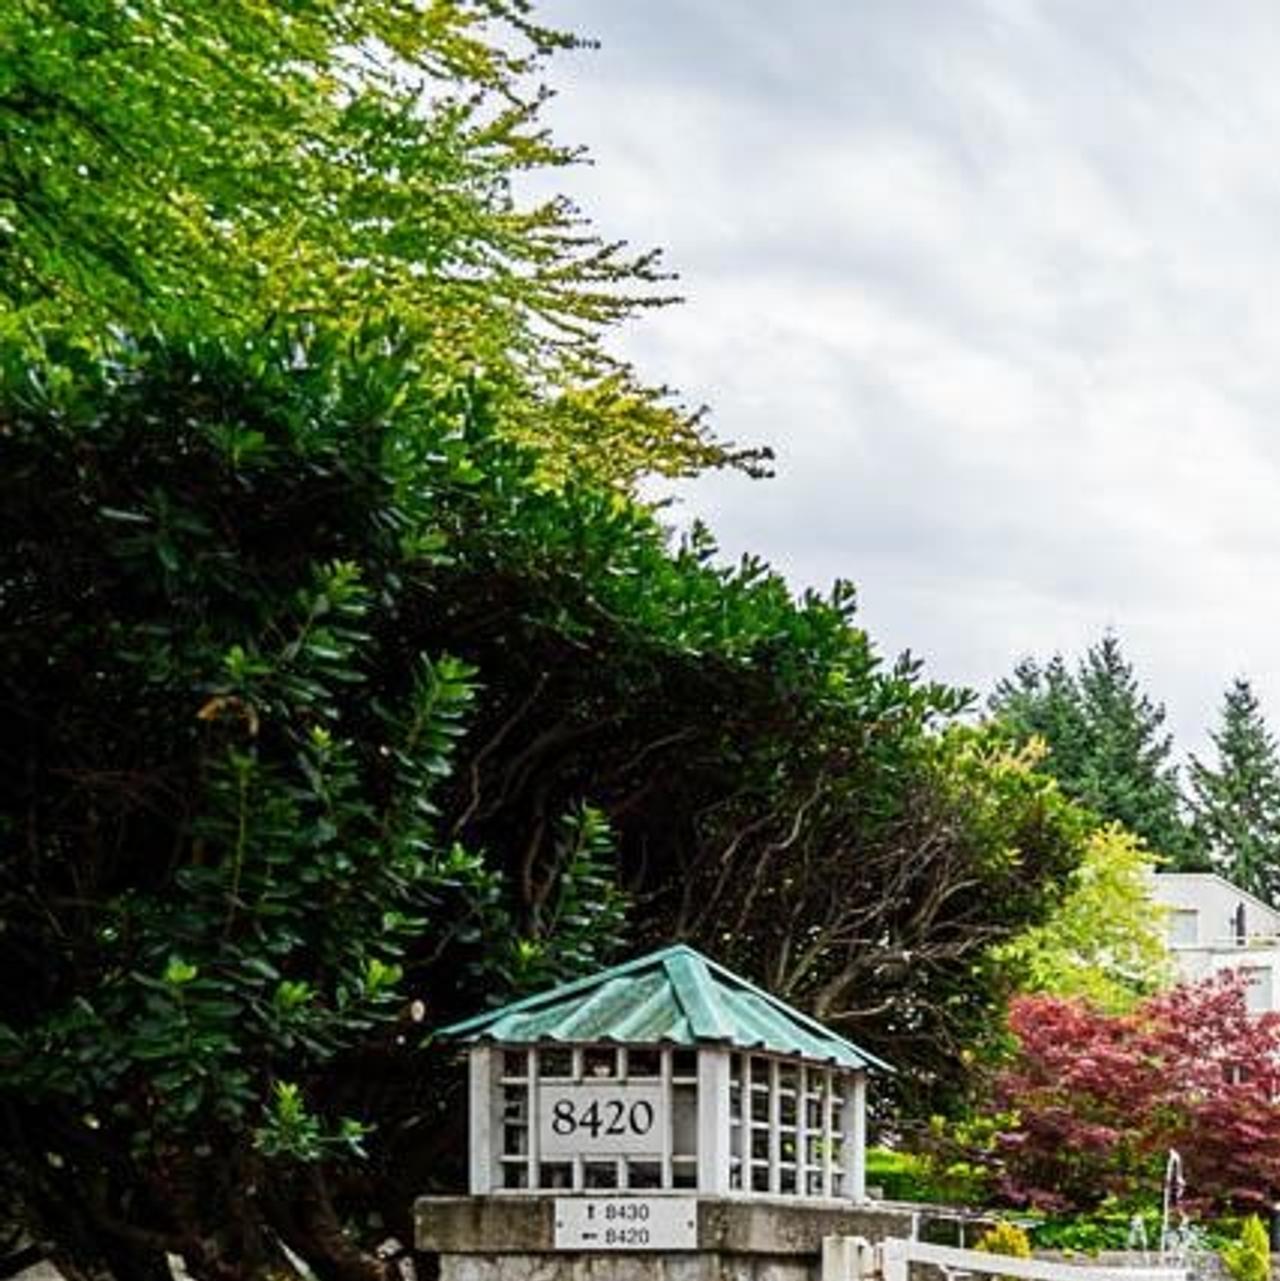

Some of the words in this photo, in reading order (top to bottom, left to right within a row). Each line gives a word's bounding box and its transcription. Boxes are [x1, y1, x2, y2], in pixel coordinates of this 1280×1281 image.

[551, 1099, 654, 1138] 8420
[605, 1204, 650, 1221] 8430
[605, 1227, 650, 1245] 8420
